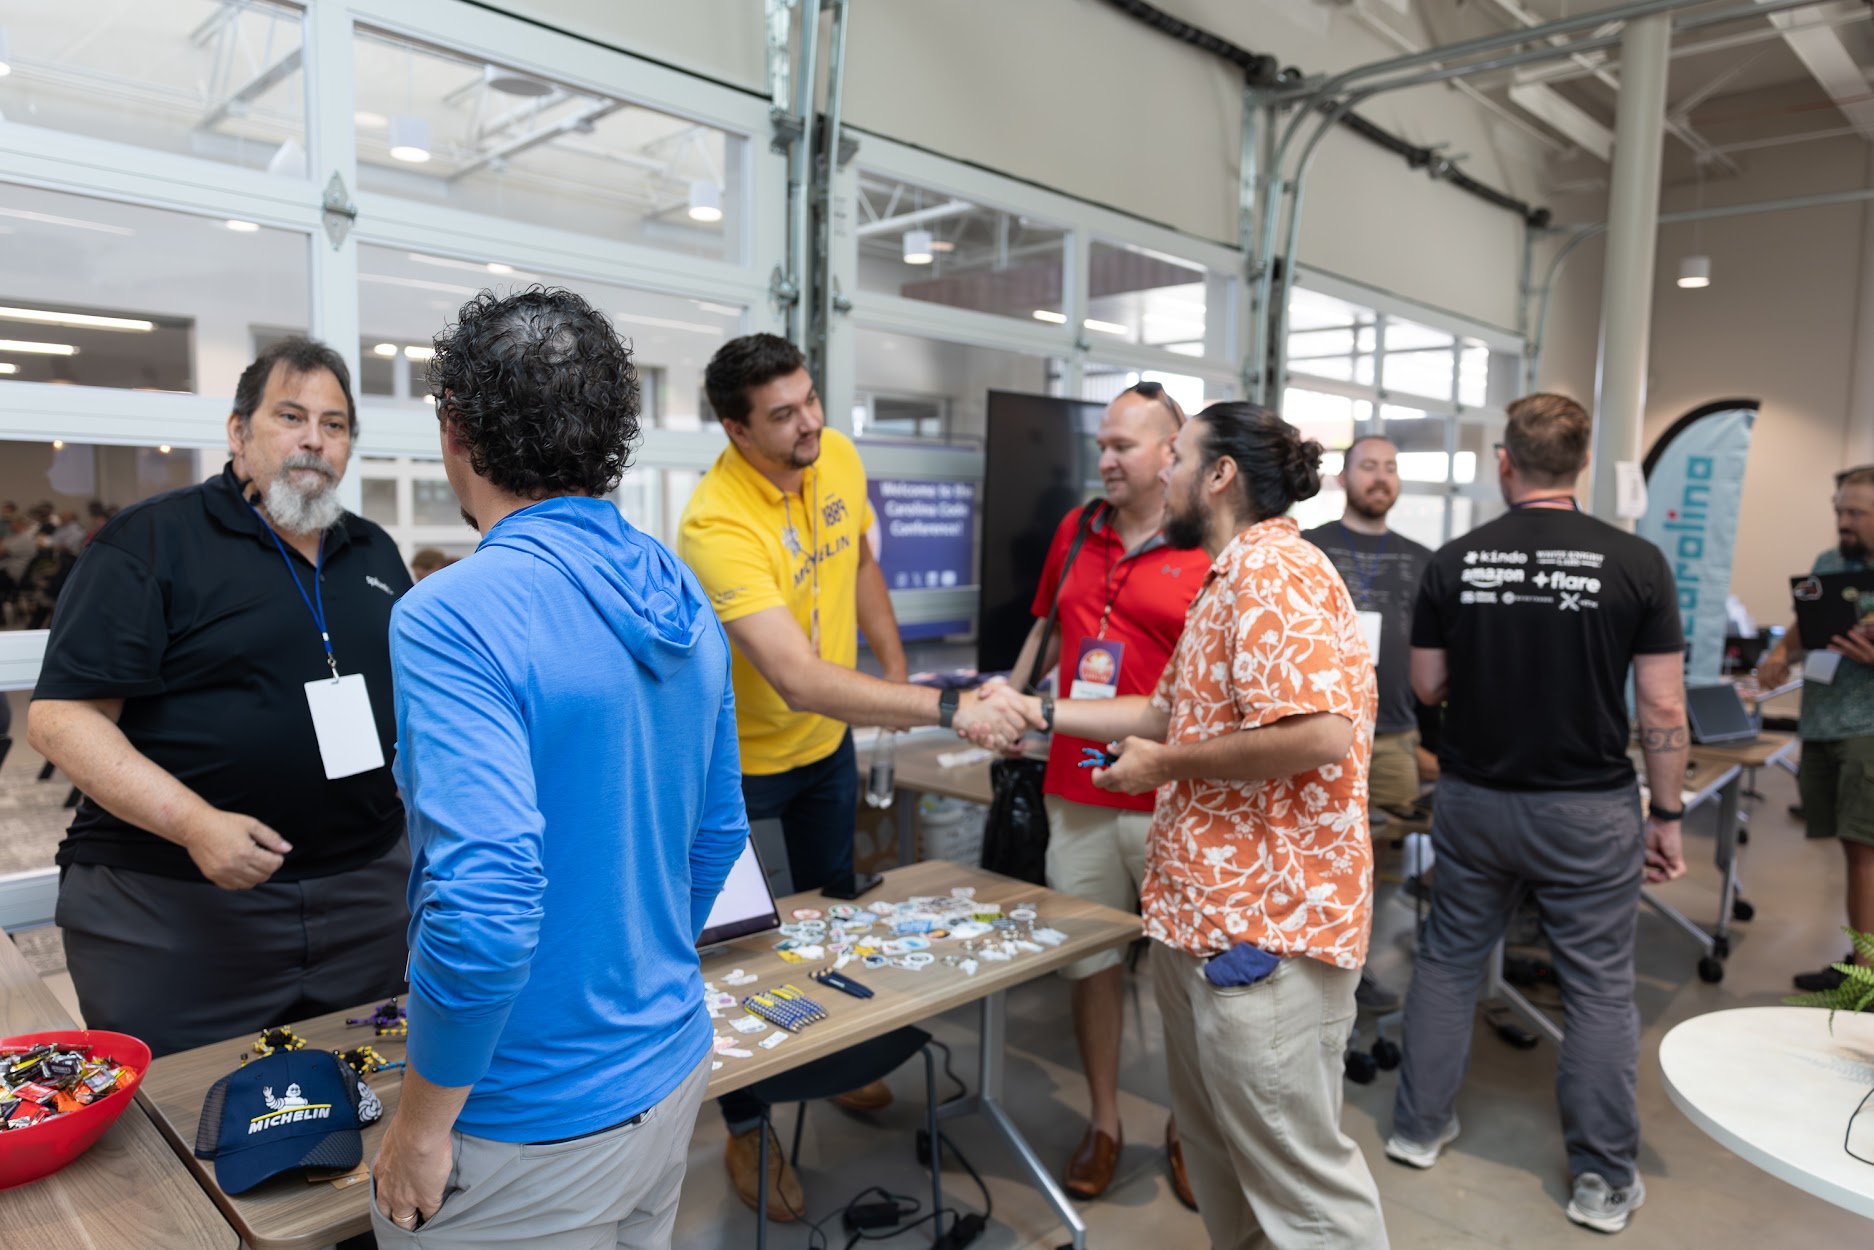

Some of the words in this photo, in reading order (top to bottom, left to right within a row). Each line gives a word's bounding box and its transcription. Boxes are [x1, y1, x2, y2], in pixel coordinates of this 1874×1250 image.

[1480, 550, 1528, 564] kindo
[1461, 567, 1525, 583] amazon
[248, 1107, 331, 1135] MICHELIN
